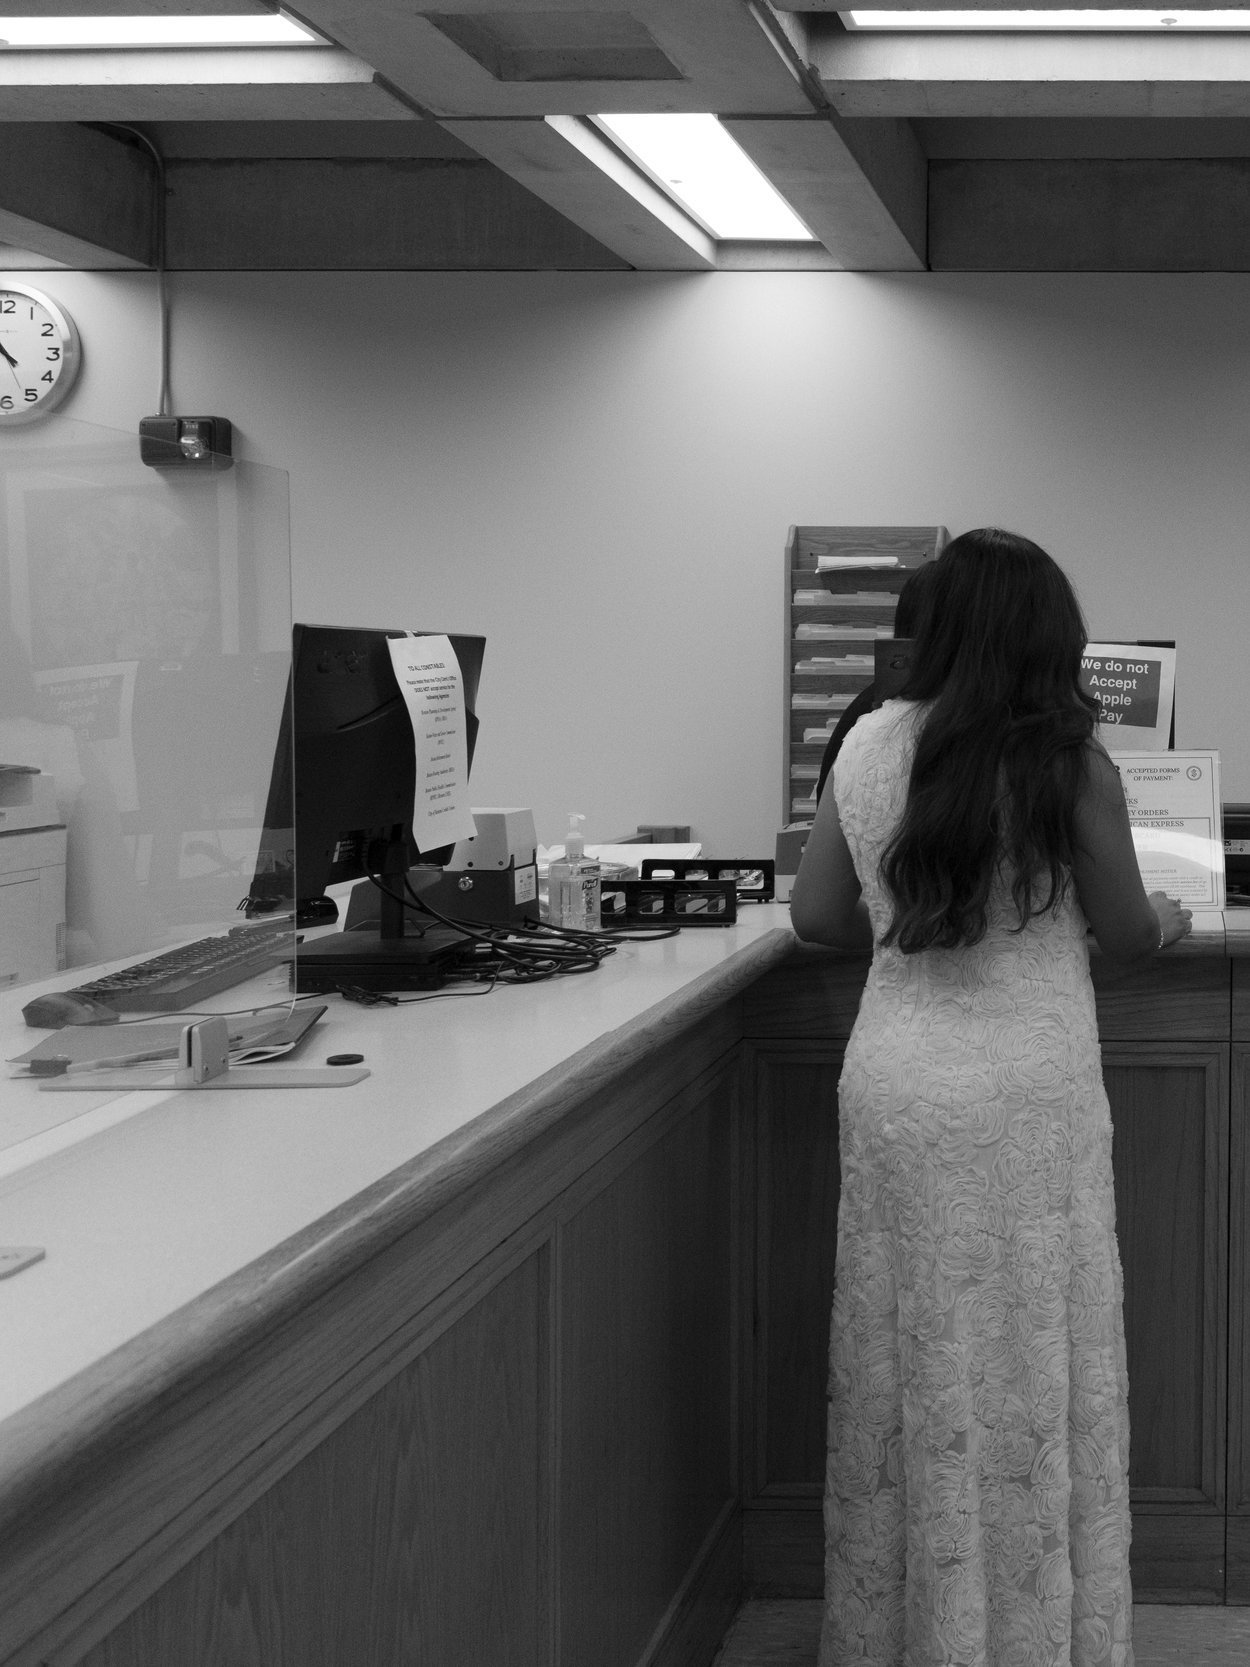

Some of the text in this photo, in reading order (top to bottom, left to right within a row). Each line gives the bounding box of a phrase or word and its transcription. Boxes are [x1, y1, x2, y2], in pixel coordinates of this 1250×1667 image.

[0, 300, 16, 314] 12
[41, 323, 54, 336] 2
[46, 347, 60, 361] 3
[41, 370, 54, 383] 4
[24, 388, 38, 402] 5
[0, 395, 14, 410] 6
[1081, 658, 1149, 674] We do not
[1089, 675, 1137, 691] Accept
[1093, 691, 1132, 707] Apple
[1098, 709, 1123, 725] Pay
[1151, 820, 1184, 828] EXPRESS
